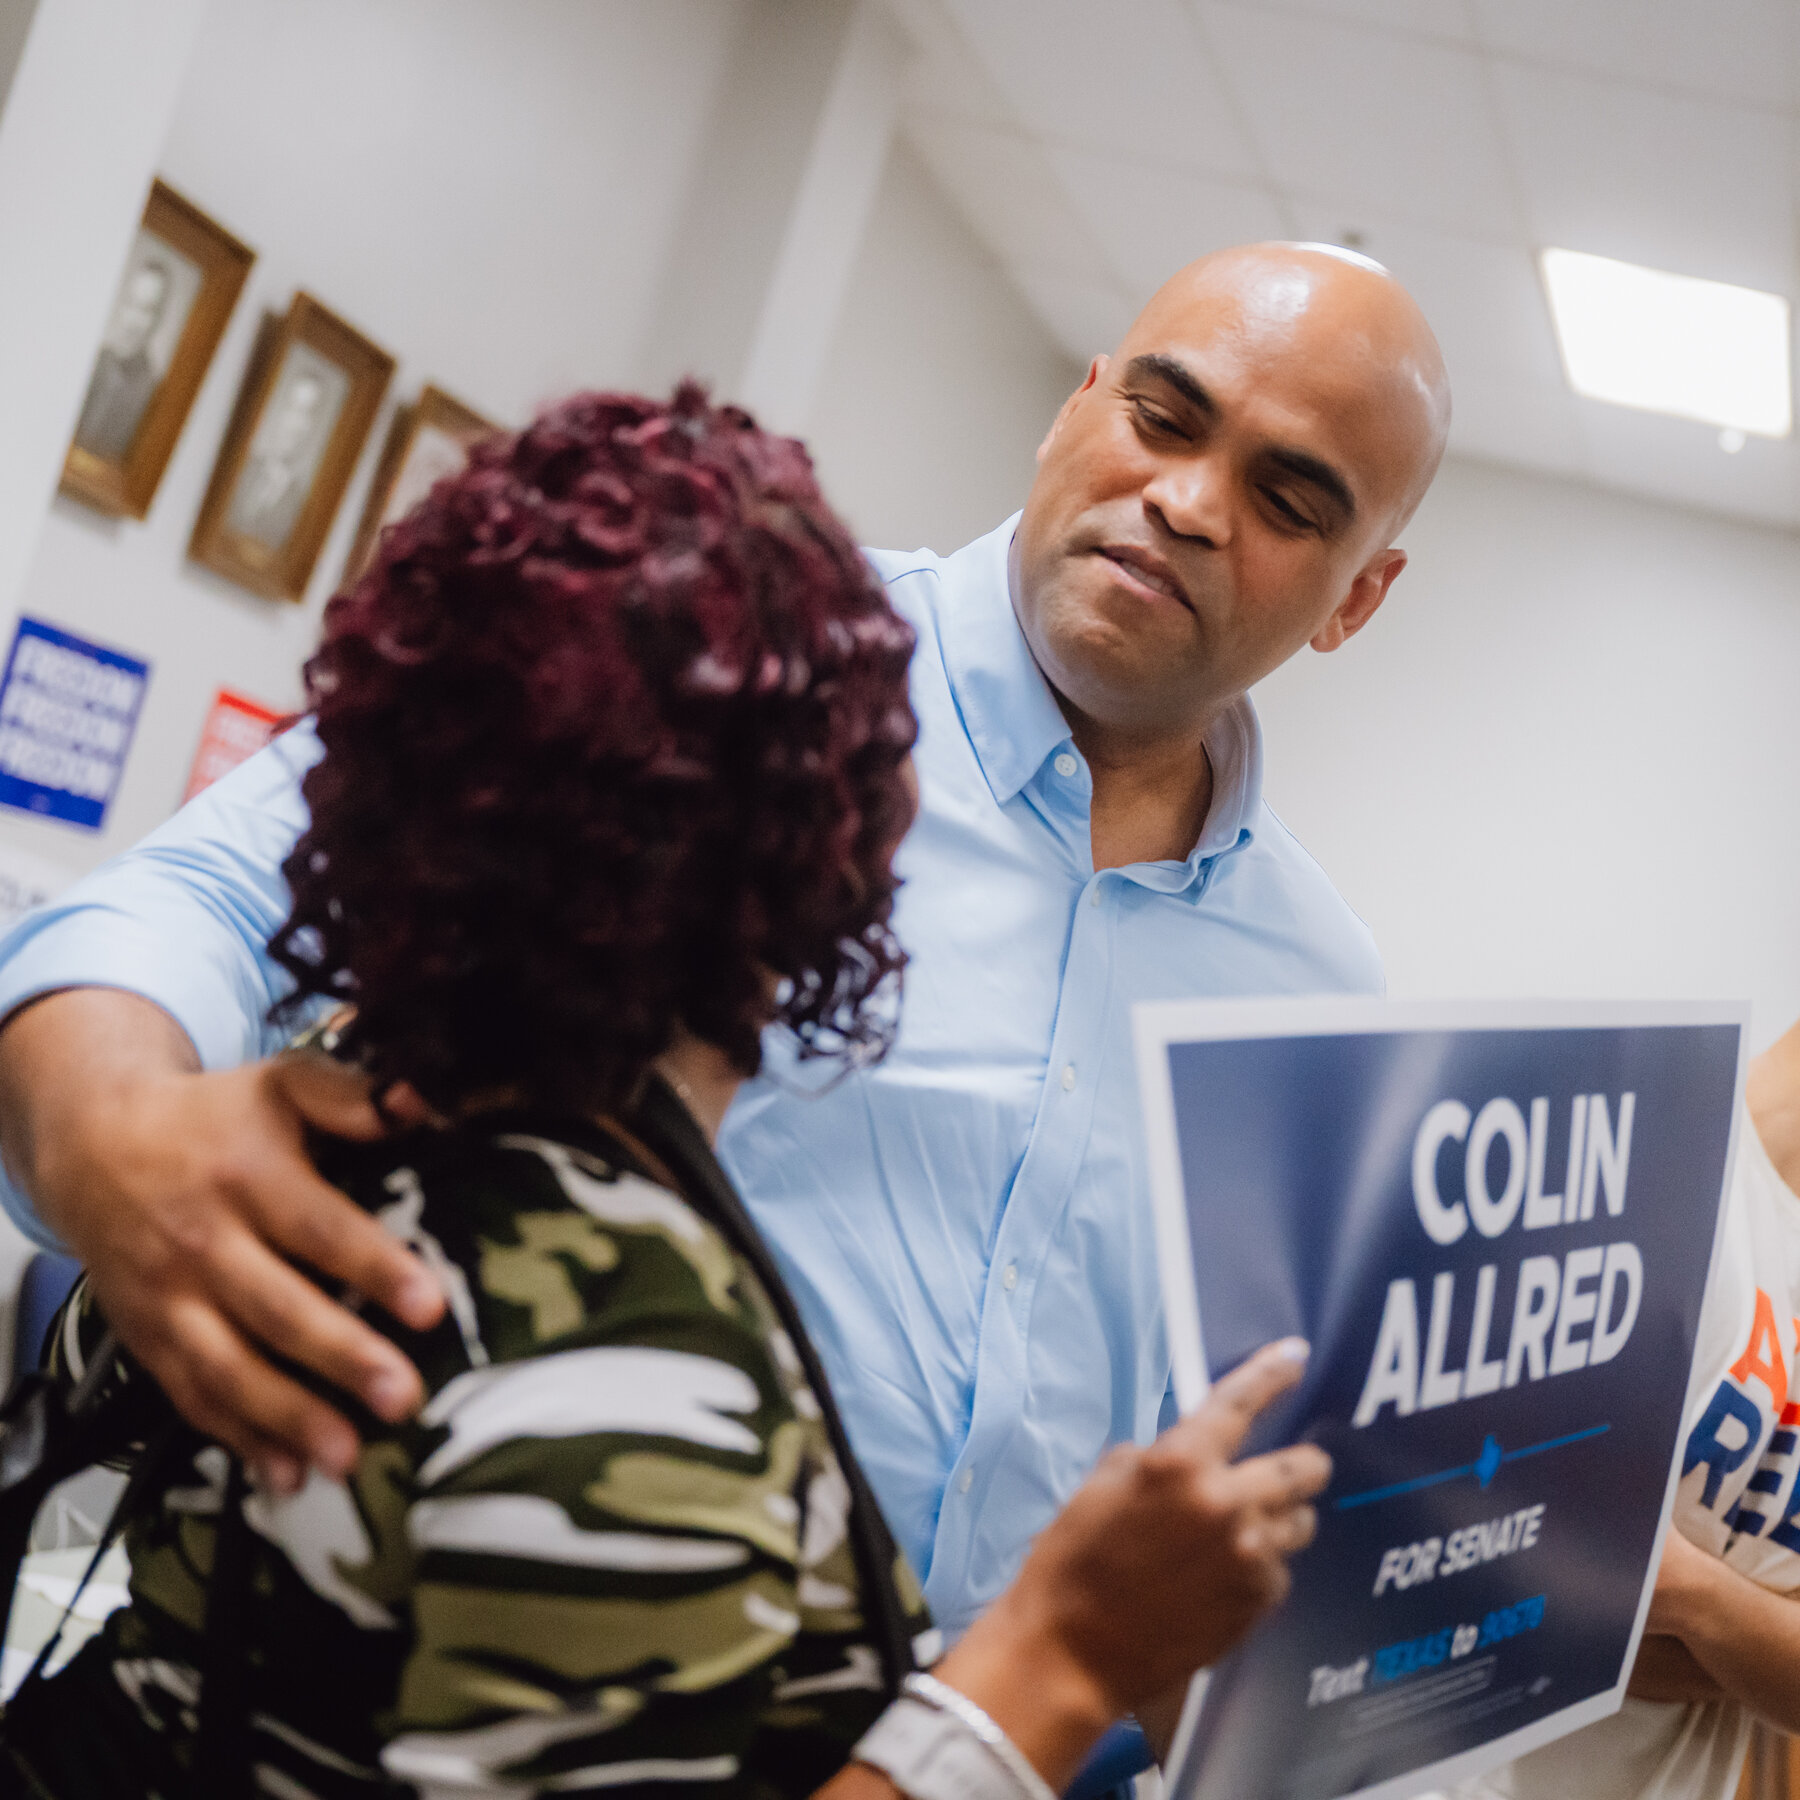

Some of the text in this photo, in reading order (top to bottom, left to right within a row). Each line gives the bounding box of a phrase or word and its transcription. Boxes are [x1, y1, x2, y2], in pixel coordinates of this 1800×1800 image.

[1411, 1091, 1637, 1246] COLIN
[1351, 1241, 1644, 1430] ALLRED
[1373, 1503, 1546, 1598] FOR SENATE
[1450, 1623, 1479, 1659] to
